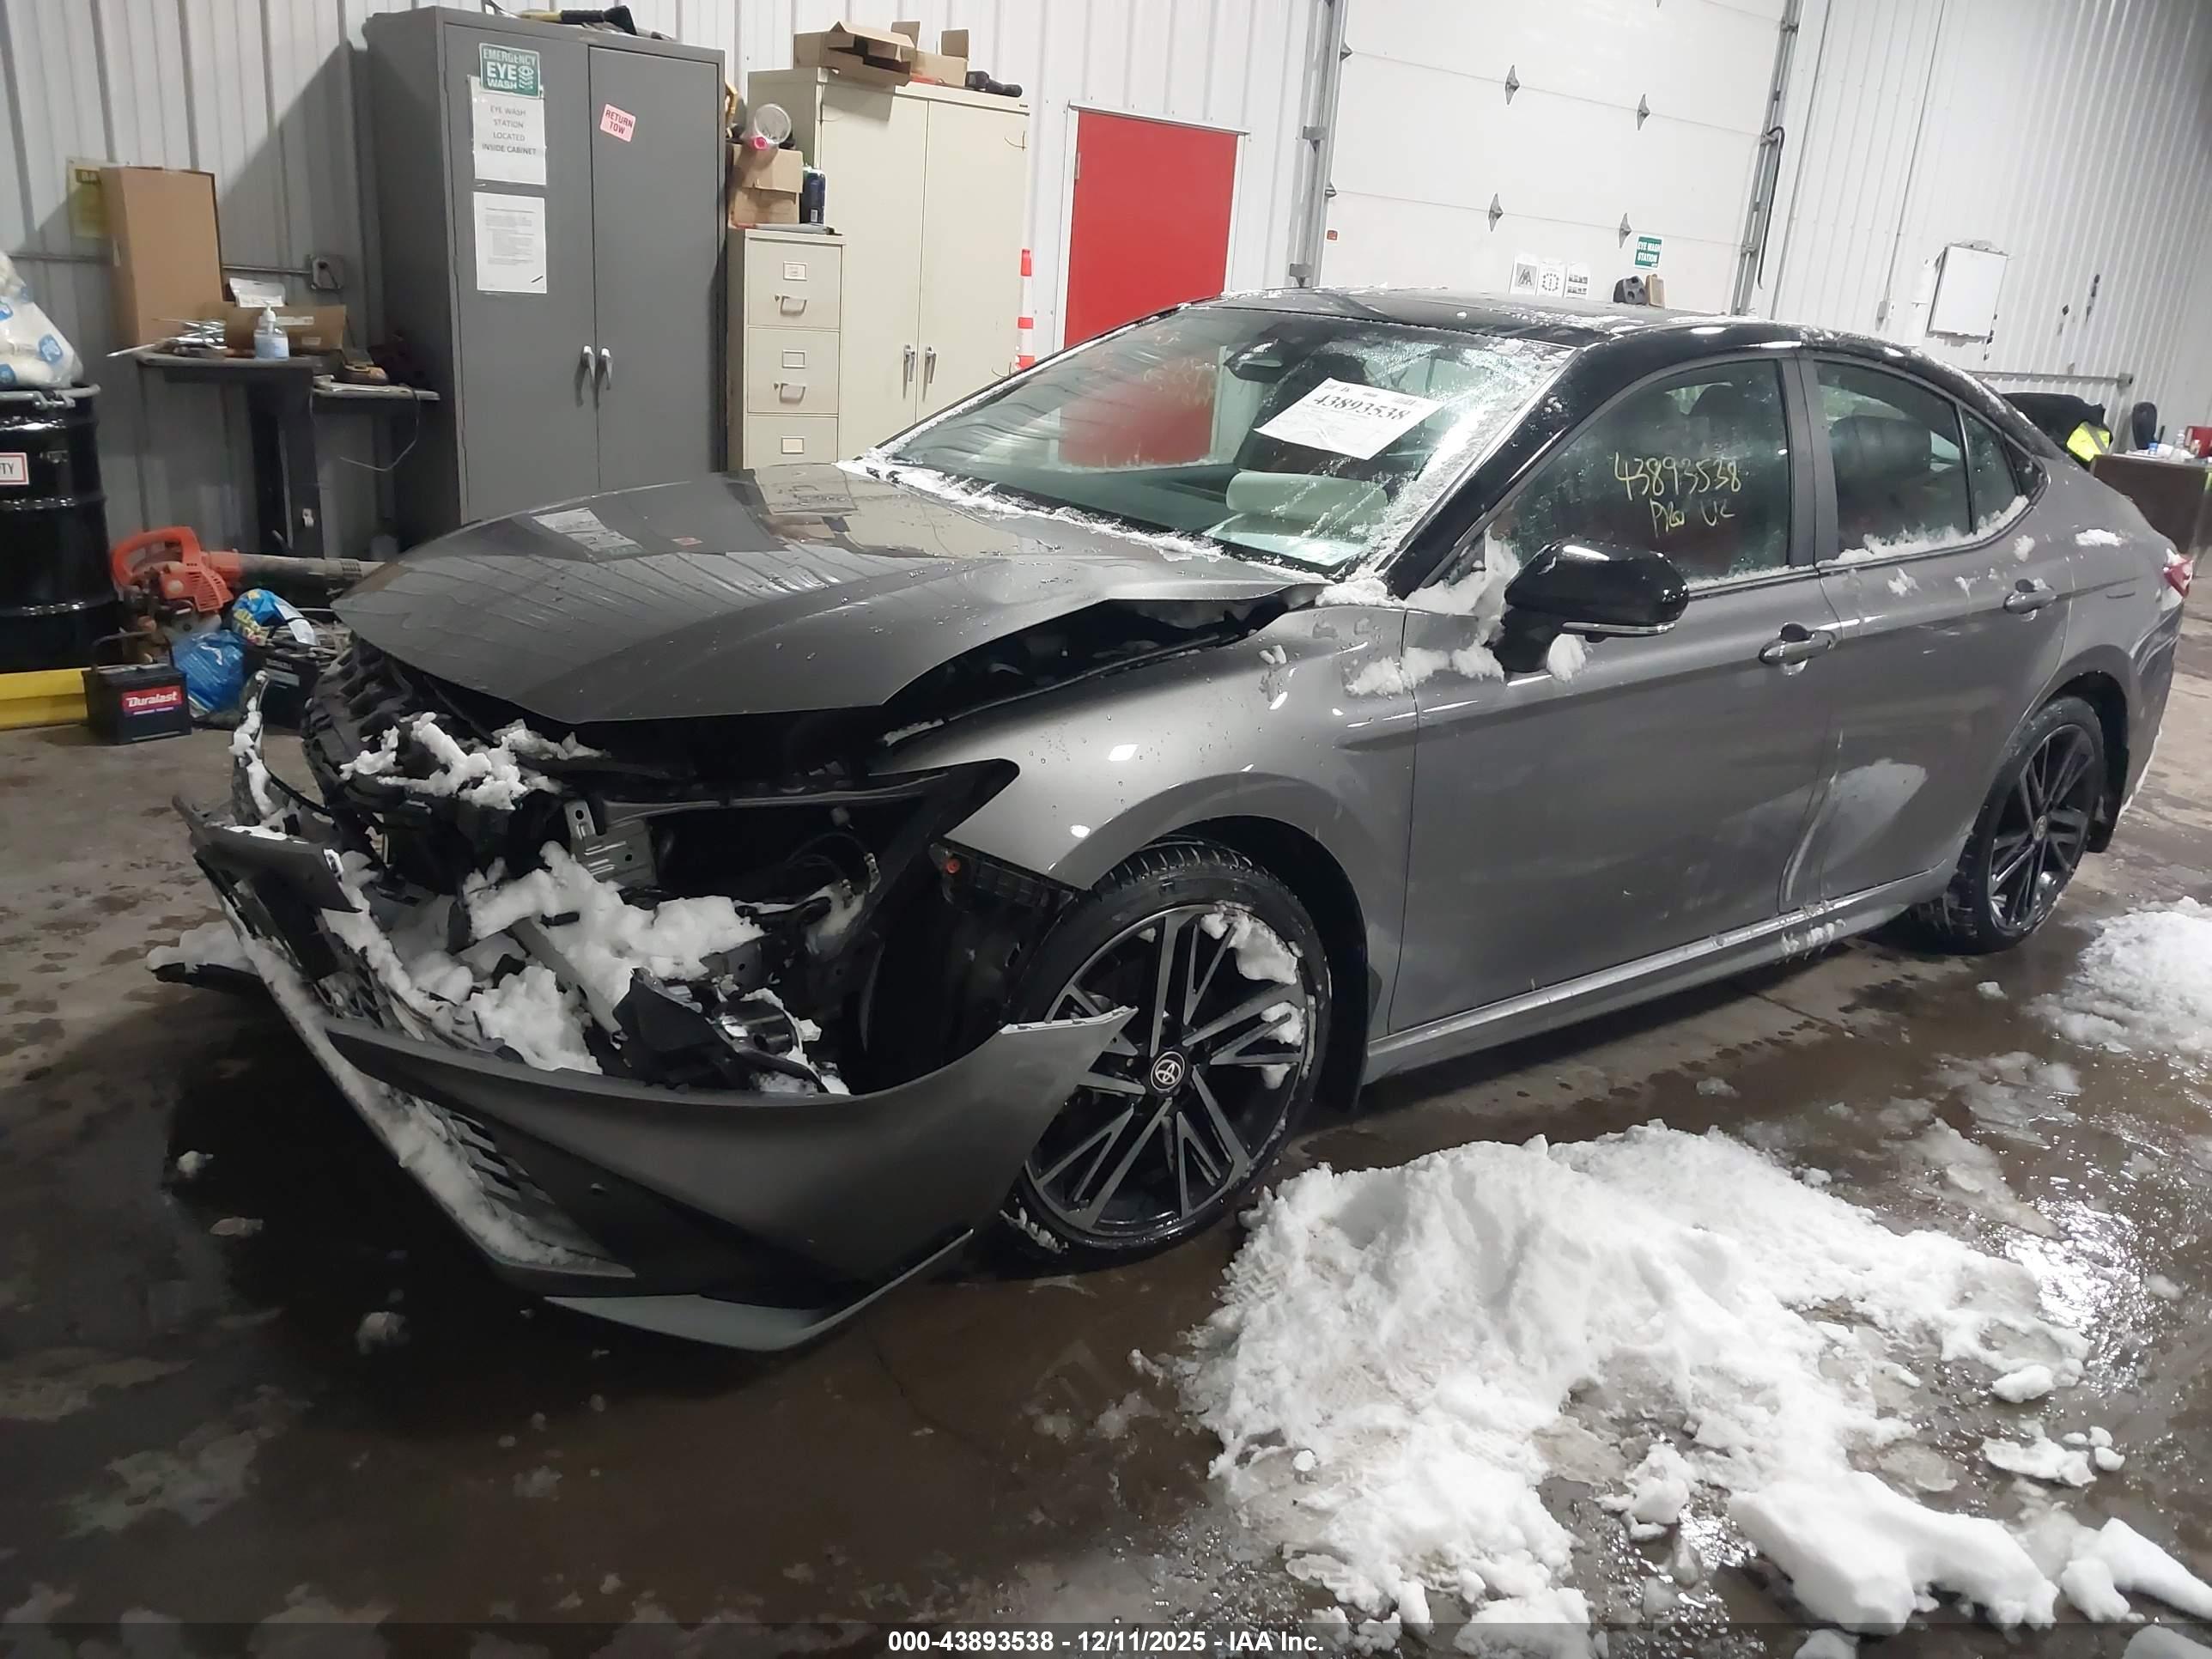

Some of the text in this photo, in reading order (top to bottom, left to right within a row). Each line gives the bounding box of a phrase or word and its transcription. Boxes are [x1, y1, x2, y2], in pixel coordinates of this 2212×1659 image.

[483, 47, 536, 66] EMERGENCY
[486, 61, 517, 80] EYE
[487, 78, 517, 89] WASH
[505, 107, 526, 116] WASH
[493, 119, 524, 128] STATION
[605, 109, 634, 128] RETURN
[610, 121, 625, 134] TOW
[493, 131, 526, 142] LOCATED
[482, 143, 536, 155] INSIDE CABINET
[1637, 252, 1658, 263] STATION
[1313, 393, 1412, 421] 43893538
[0, 462, 14, 475] TY
[1613, 451, 1742, 501] 43893538
[125, 690, 179, 708] Duralast
